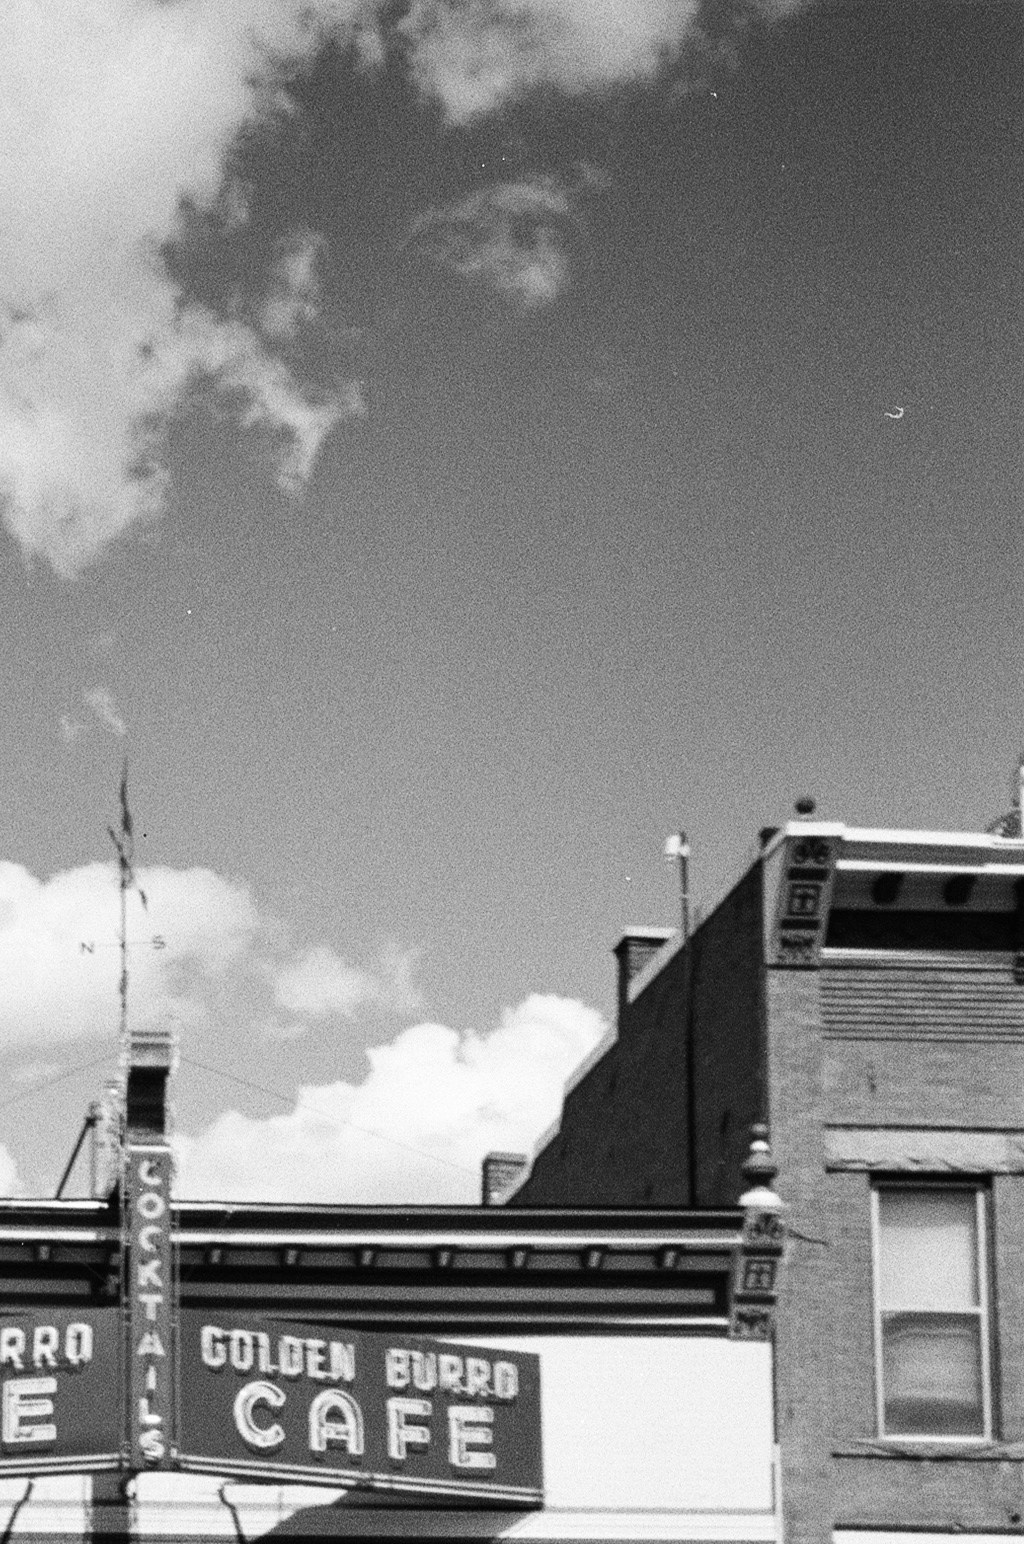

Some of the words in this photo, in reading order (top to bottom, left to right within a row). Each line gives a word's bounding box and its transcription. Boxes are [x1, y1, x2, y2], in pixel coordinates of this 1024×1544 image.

[136, 1159, 166, 1459] COCKTAILS
[200, 1325, 356, 1382] GOLDEN
[384, 1347, 519, 1399] BURRO
[233, 1380, 497, 1469] CAFE
